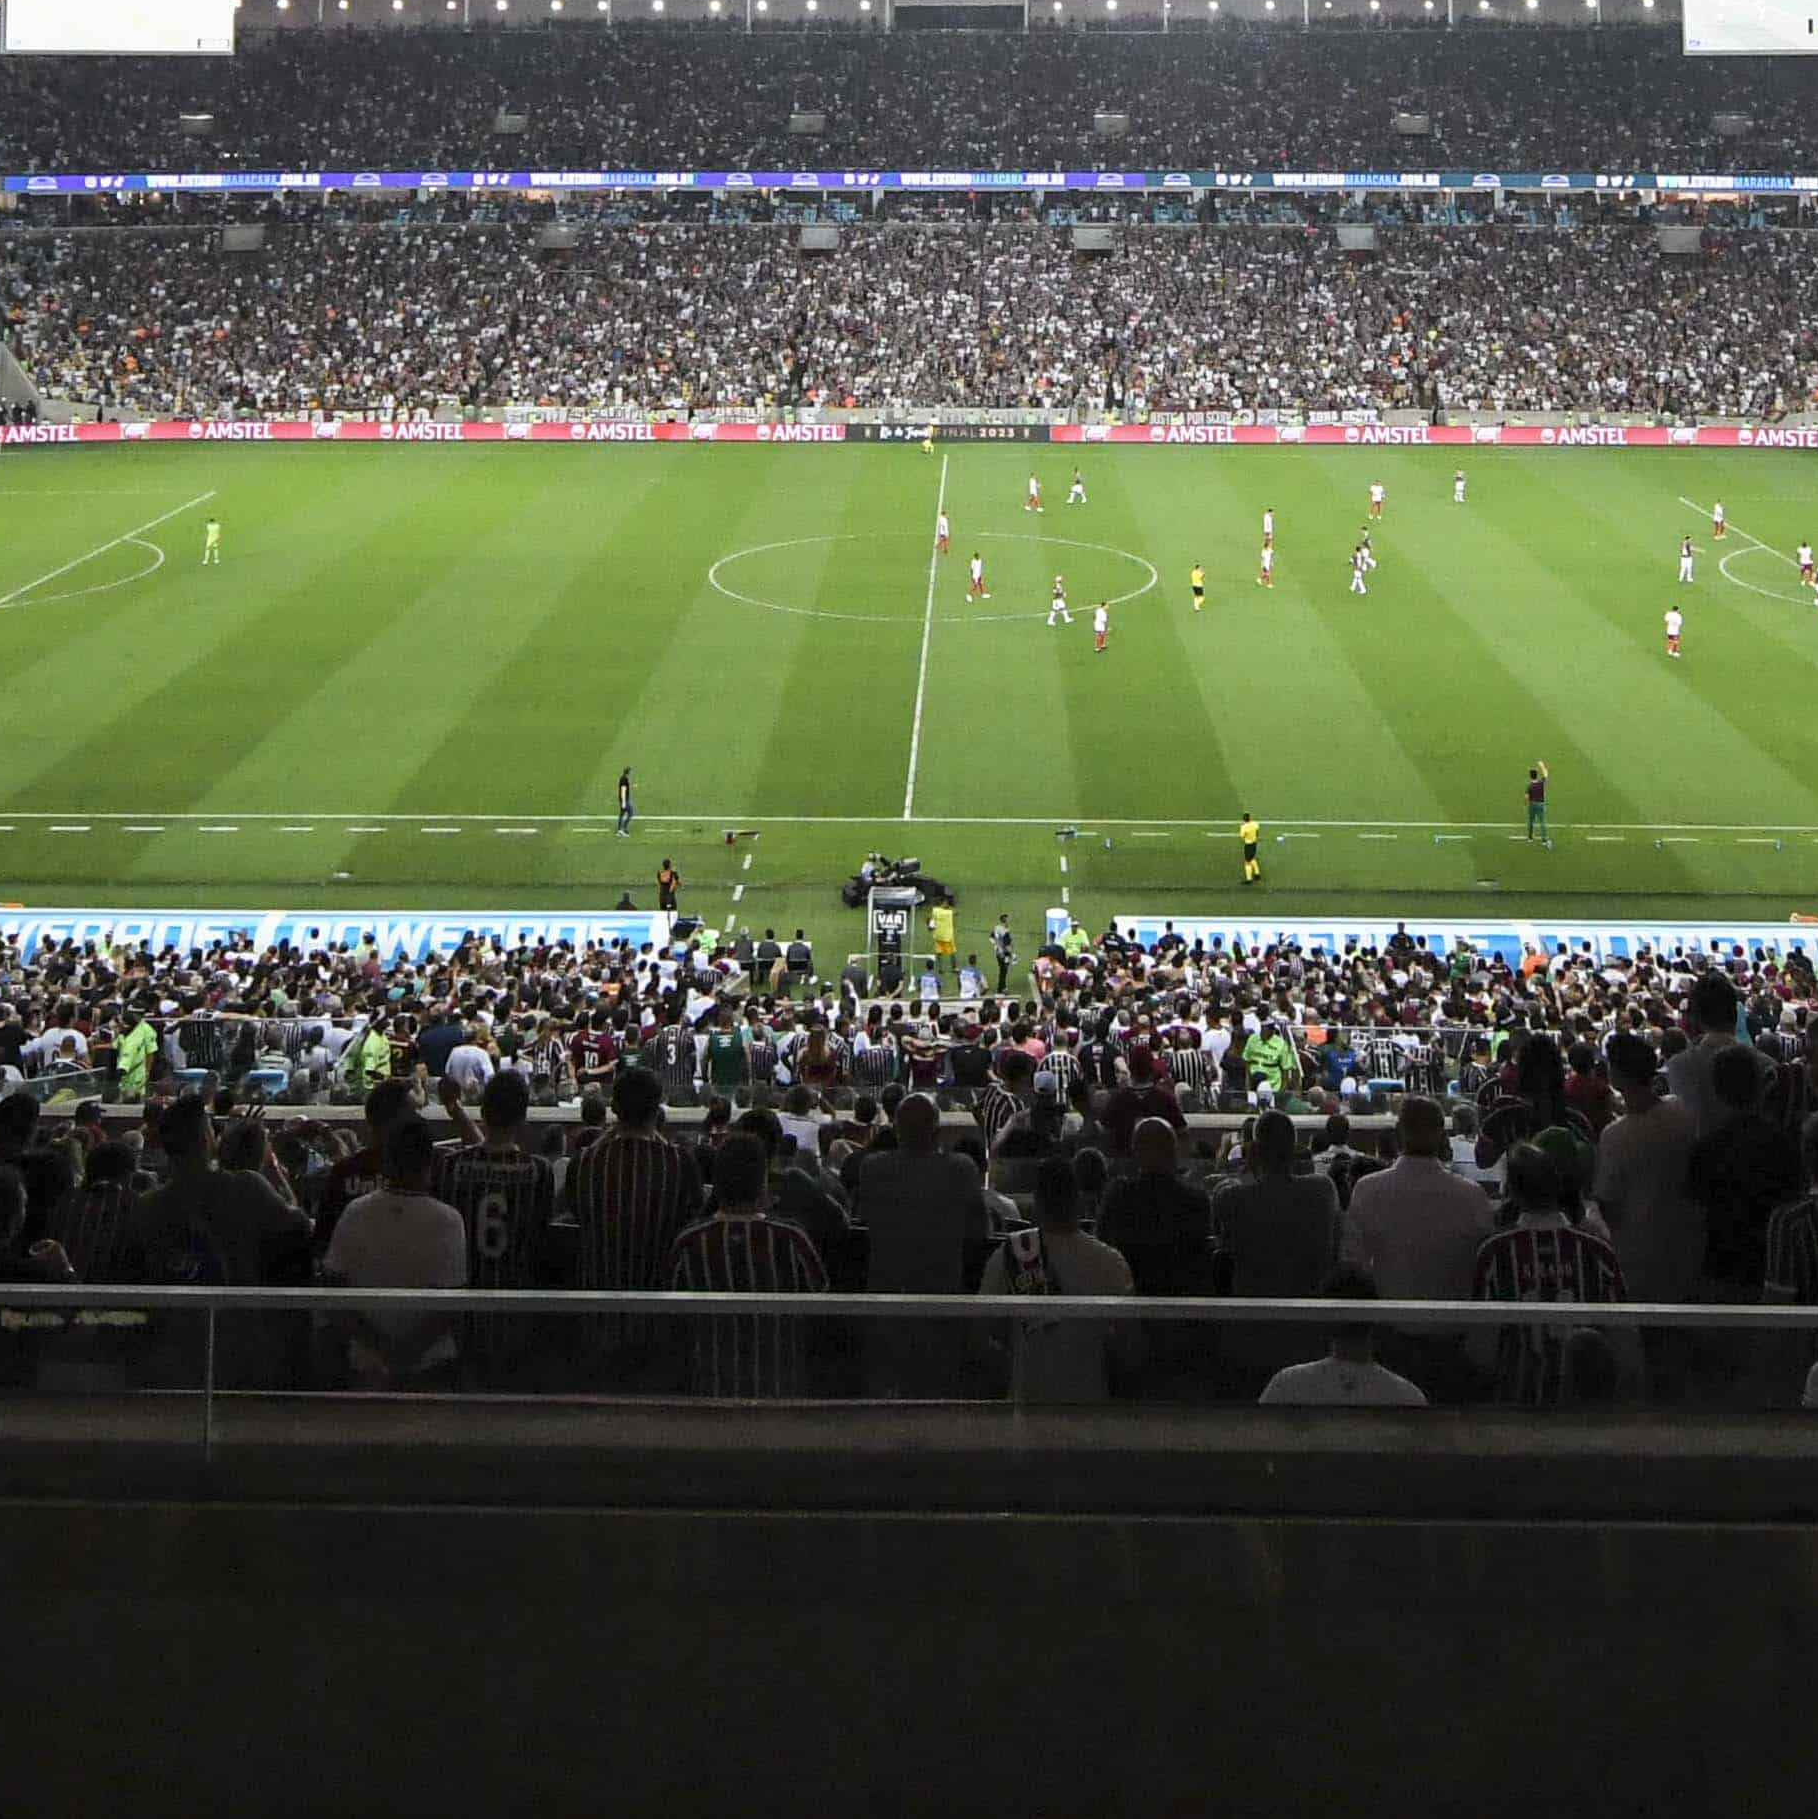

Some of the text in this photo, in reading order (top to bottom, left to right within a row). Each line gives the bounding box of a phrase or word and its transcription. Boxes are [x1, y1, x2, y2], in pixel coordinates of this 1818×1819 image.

[5, 425, 78, 443] AMSTEL
[204, 422, 274, 439] AMSTEL
[396, 423, 465, 440] AMSTEL
[587, 424, 657, 440] AMSTEL
[773, 424, 844, 441] AMSTEL
[979, 427, 1015, 438] 2023
[1167, 426, 1237, 442] AMSTEL
[1362, 426, 1432, 443] AMSTEL
[1557, 427, 1627, 444] AMSTEL
[878, 914, 902, 925] VAR
[583, 1050, 599, 1067] 10
[666, 1043, 677, 1066] 3
[478, 1191, 509, 1257] 6
